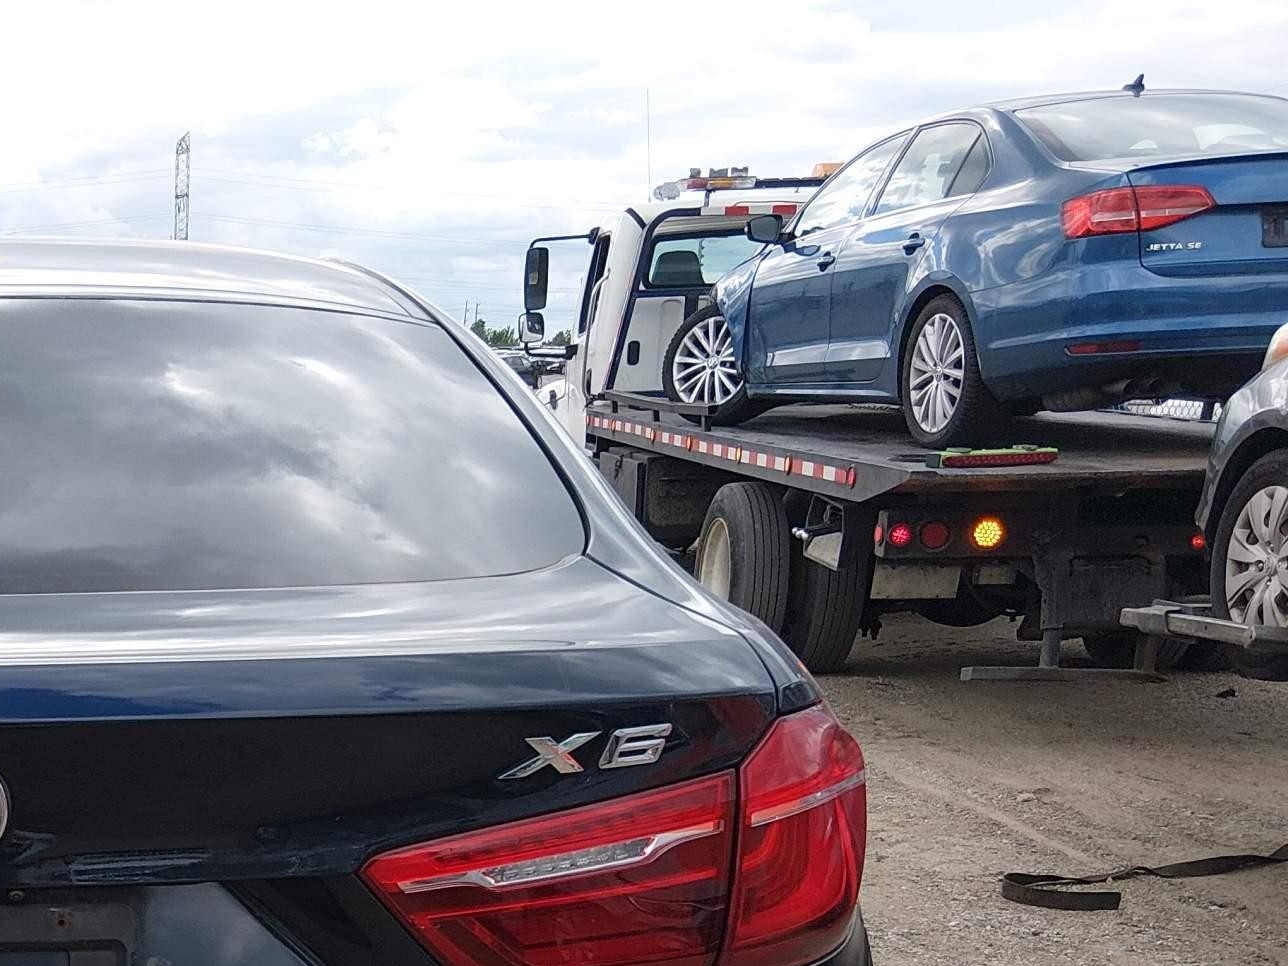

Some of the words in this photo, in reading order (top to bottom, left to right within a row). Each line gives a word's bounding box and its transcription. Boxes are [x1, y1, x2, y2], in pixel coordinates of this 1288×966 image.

[1146, 243, 1183, 252] JETTA
[1187, 242, 1202, 250] SE
[497, 722, 673, 780] X6
